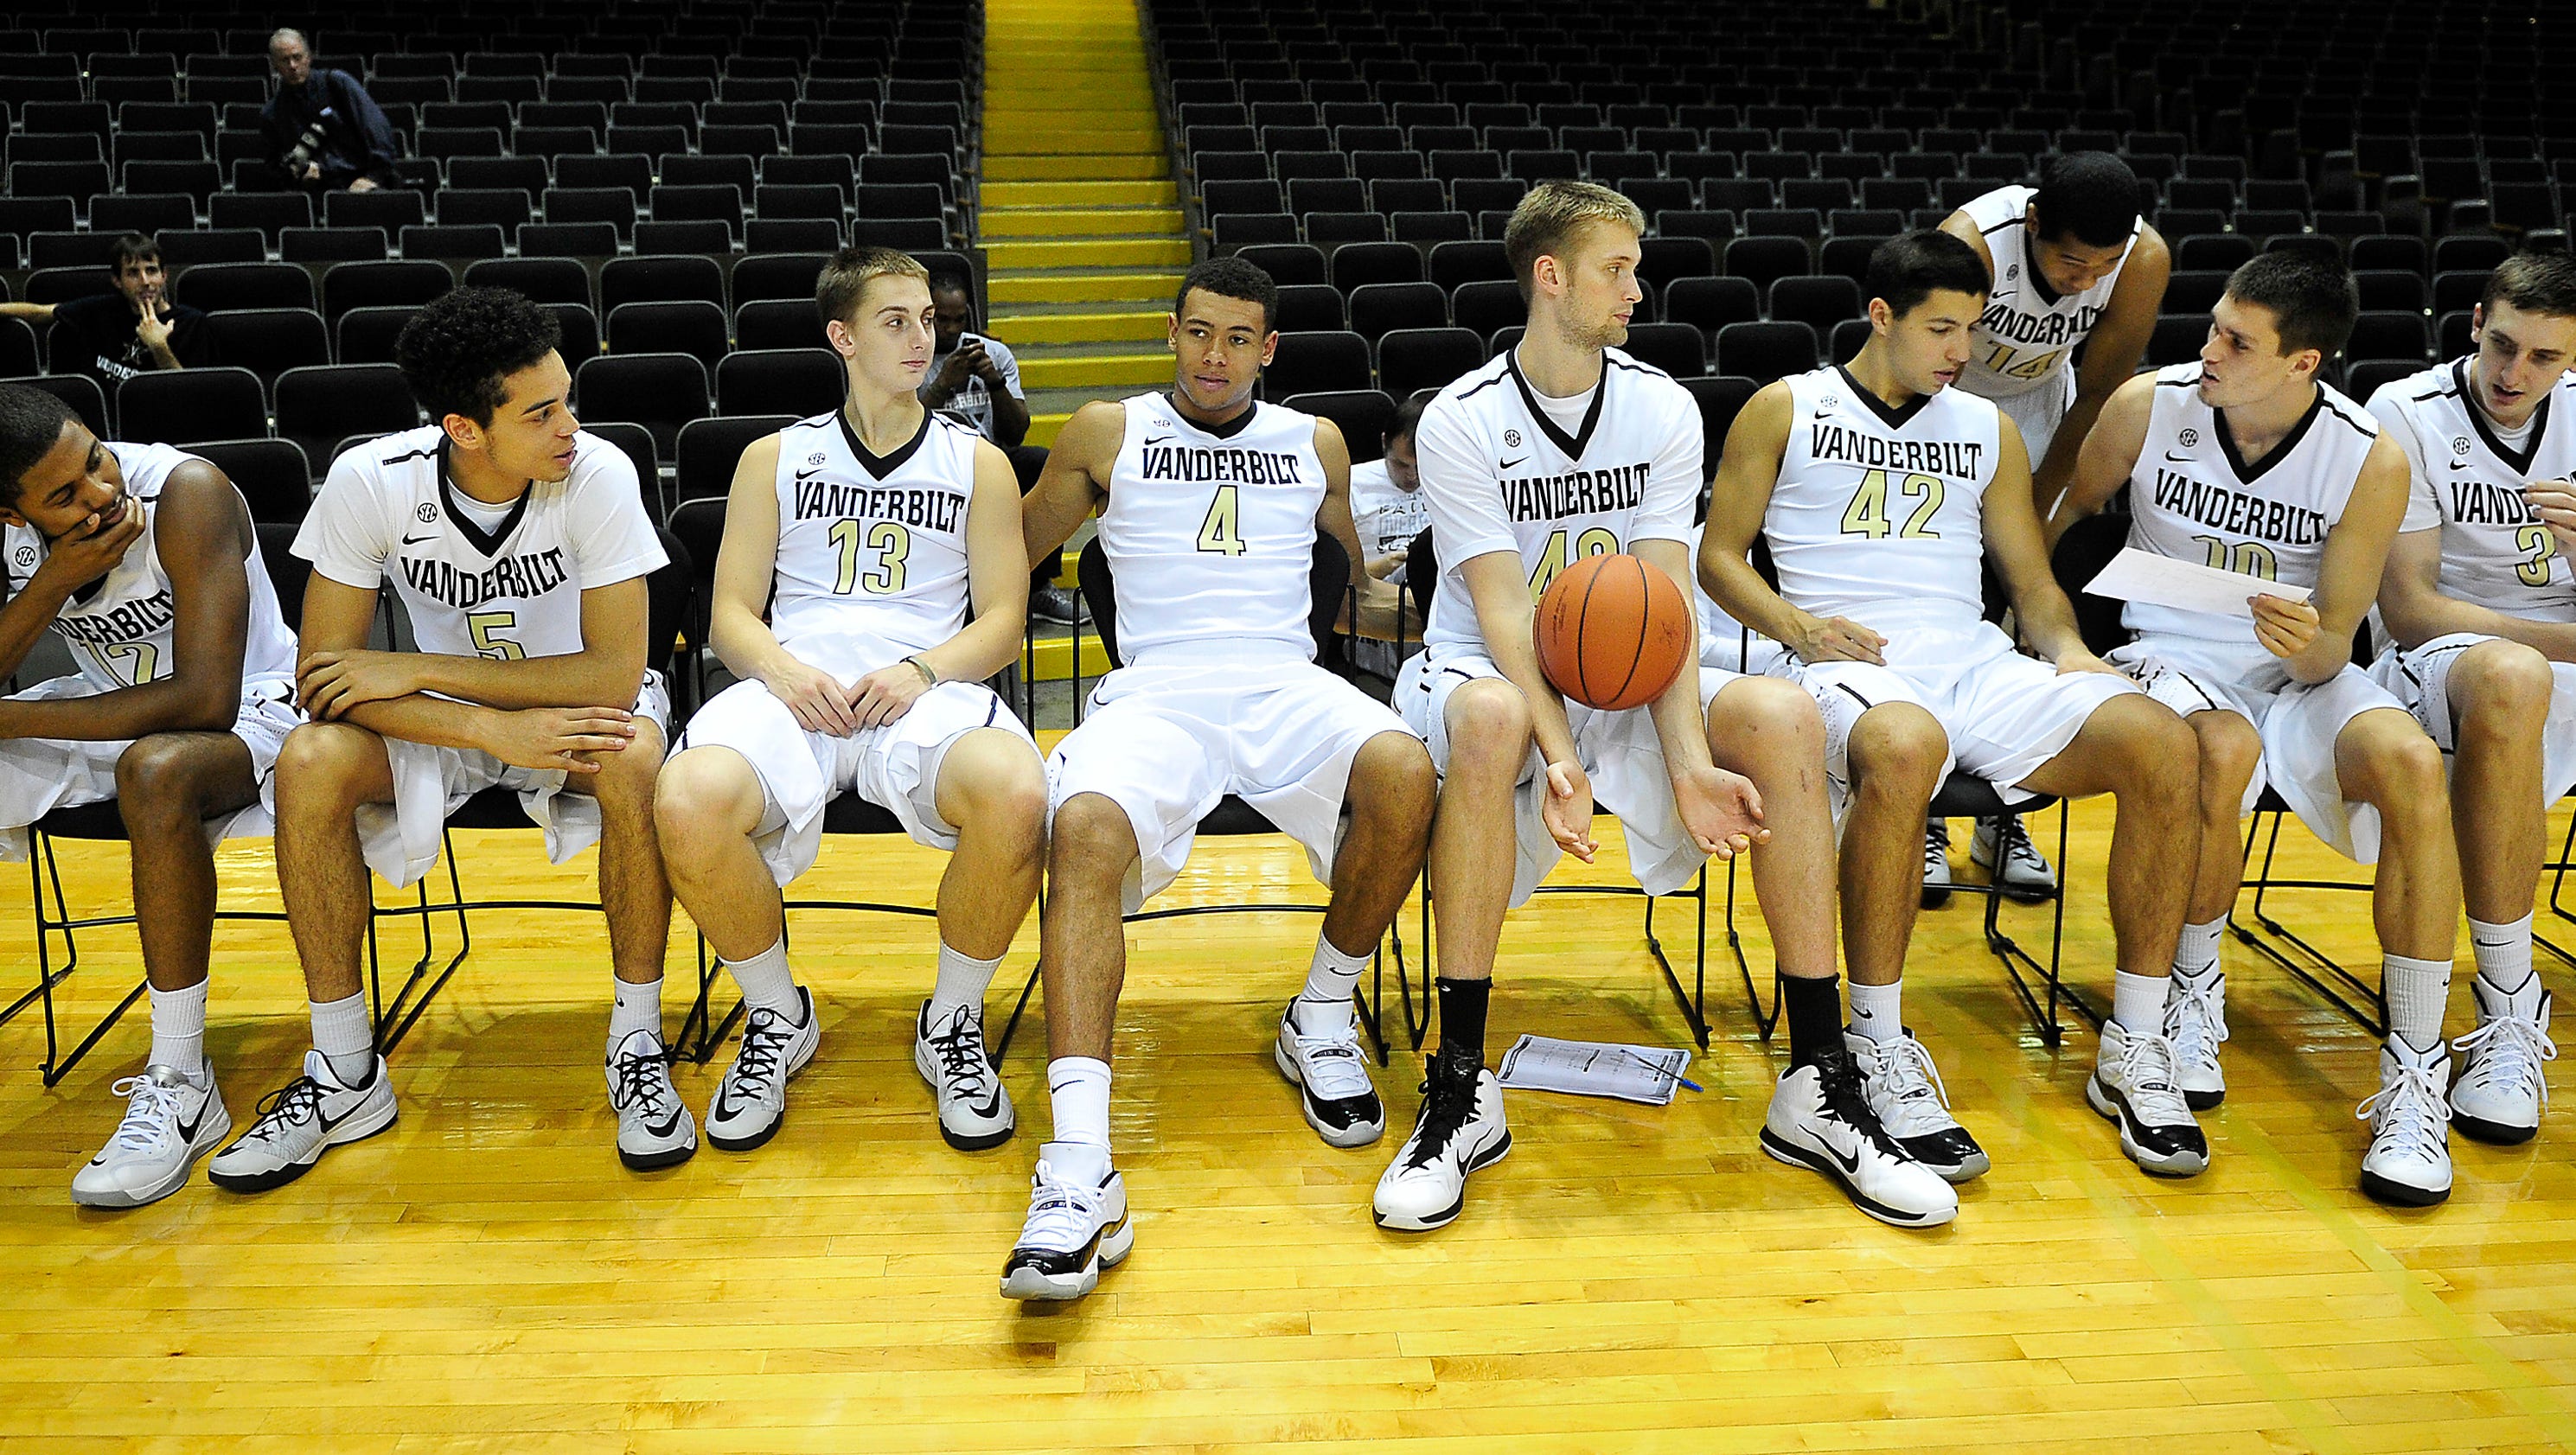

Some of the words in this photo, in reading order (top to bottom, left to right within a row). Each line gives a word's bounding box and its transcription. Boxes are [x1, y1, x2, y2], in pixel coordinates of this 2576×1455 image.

[1142, 447, 1301, 484] VANDERBILT
[1505, 430, 1521, 448] SEC
[1812, 424, 1982, 480] VANDERBILT
[2453, 437, 2471, 455] SEC
[417, 502, 438, 523] SEC
[795, 481, 966, 533] VANDERBILT
[1197, 484, 1246, 556] 4
[1500, 463, 1651, 522] VANDERBILT
[1841, 468, 1945, 539] 42
[2154, 468, 2329, 546] VANDERBILT
[16, 546, 35, 566] SEC
[400, 546, 568, 609] VANDERBILT
[828, 519, 911, 594] 13
[1528, 527, 1620, 608] 4
[2515, 525, 2555, 587] 3
[467, 611, 526, 660] 5
